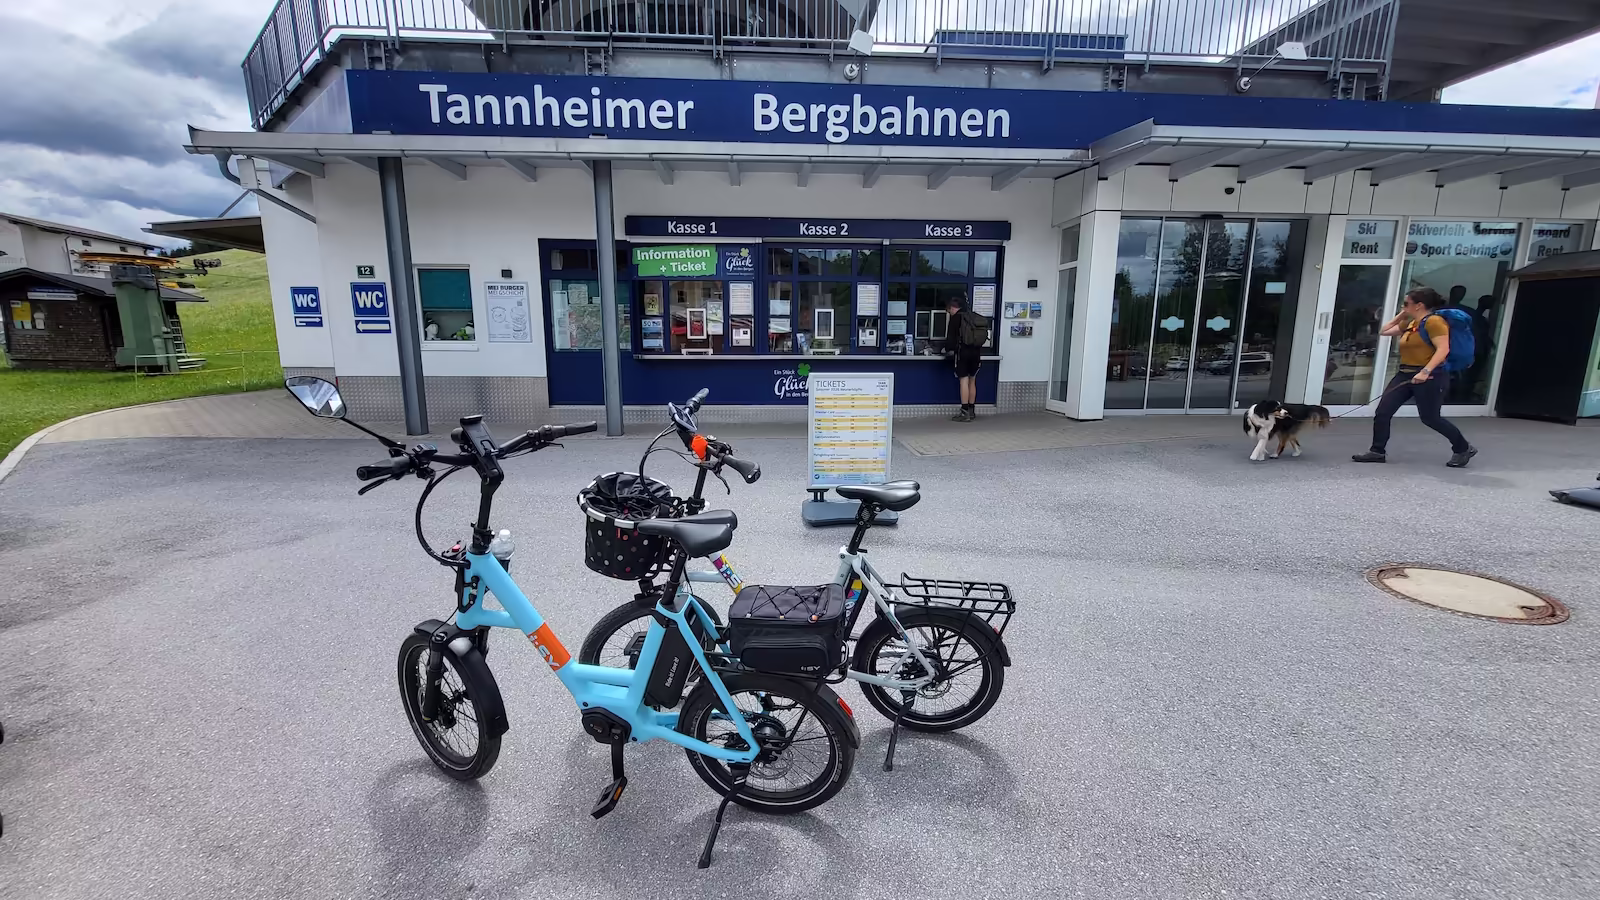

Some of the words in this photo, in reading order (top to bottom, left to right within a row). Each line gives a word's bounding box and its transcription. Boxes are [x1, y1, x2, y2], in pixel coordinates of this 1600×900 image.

[418, 83, 694, 130] Tannheimer
[753, 92, 1010, 143] Bergbahnen
[667, 221, 706, 234] Kasse
[709, 222, 718, 234] 1
[799, 223, 837, 235] Kasse
[840, 223, 849, 235] 2
[925, 224, 962, 237] Kasse
[964, 224, 973, 237] 3
[1357, 222, 1378, 235] Ski
[1408, 223, 1465, 237] Skiverleih
[636, 247, 711, 261] Information
[1350, 241, 1379, 254] Rent
[1420, 243, 1452, 257] Sport
[1454, 244, 1500, 258] Gehring
[1537, 245, 1564, 257] Rent
[670, 261, 707, 272] Ticket
[725, 255, 754, 272] Glück
[360, 267, 371, 275] 12
[294, 293, 317, 307] WC
[355, 290, 385, 309] WC
[815, 380, 846, 388] TICKETS
